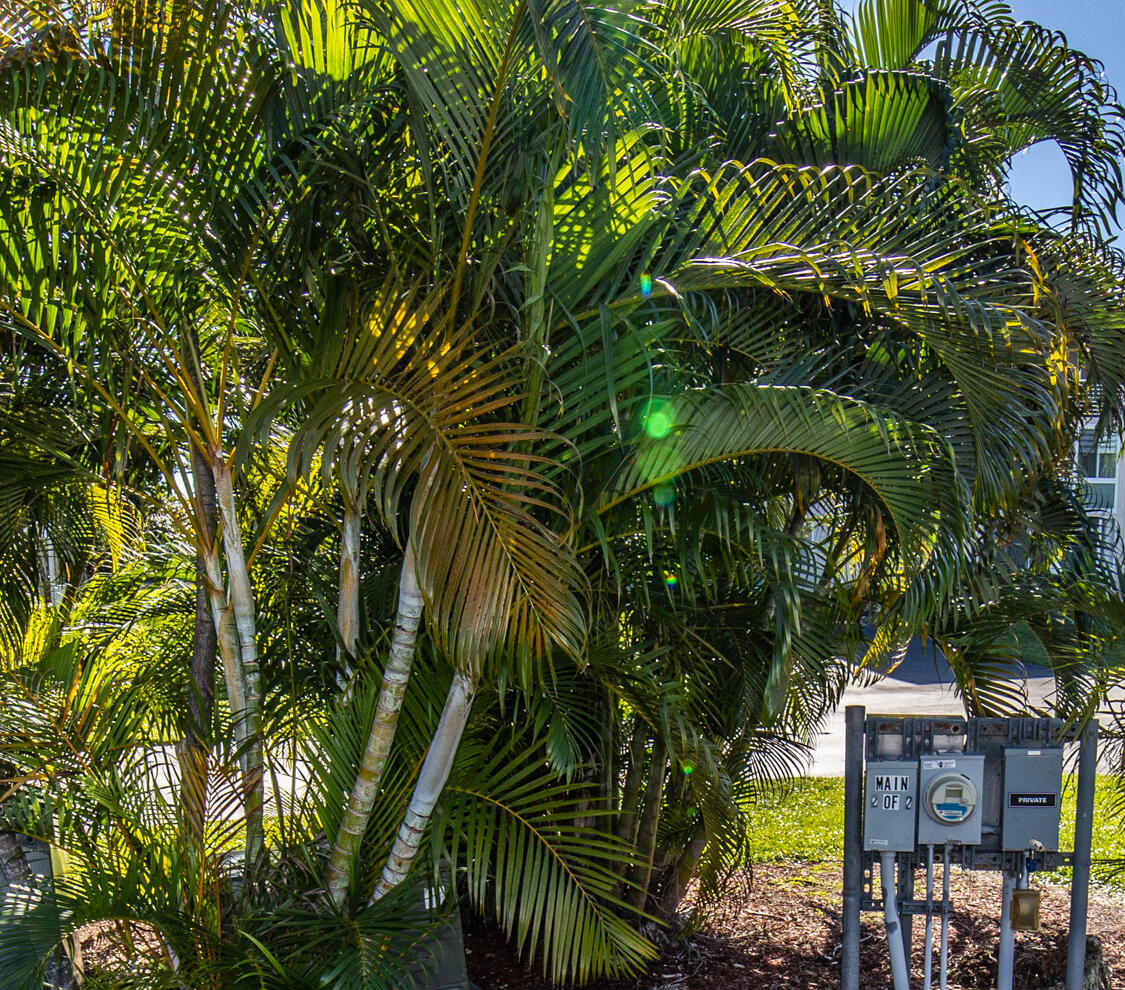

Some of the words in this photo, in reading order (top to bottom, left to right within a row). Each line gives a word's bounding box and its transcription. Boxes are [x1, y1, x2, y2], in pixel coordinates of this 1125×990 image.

[876, 776, 908, 791] MAIN
[883, 795, 899, 809] OF
[905, 796, 913, 809] 2
